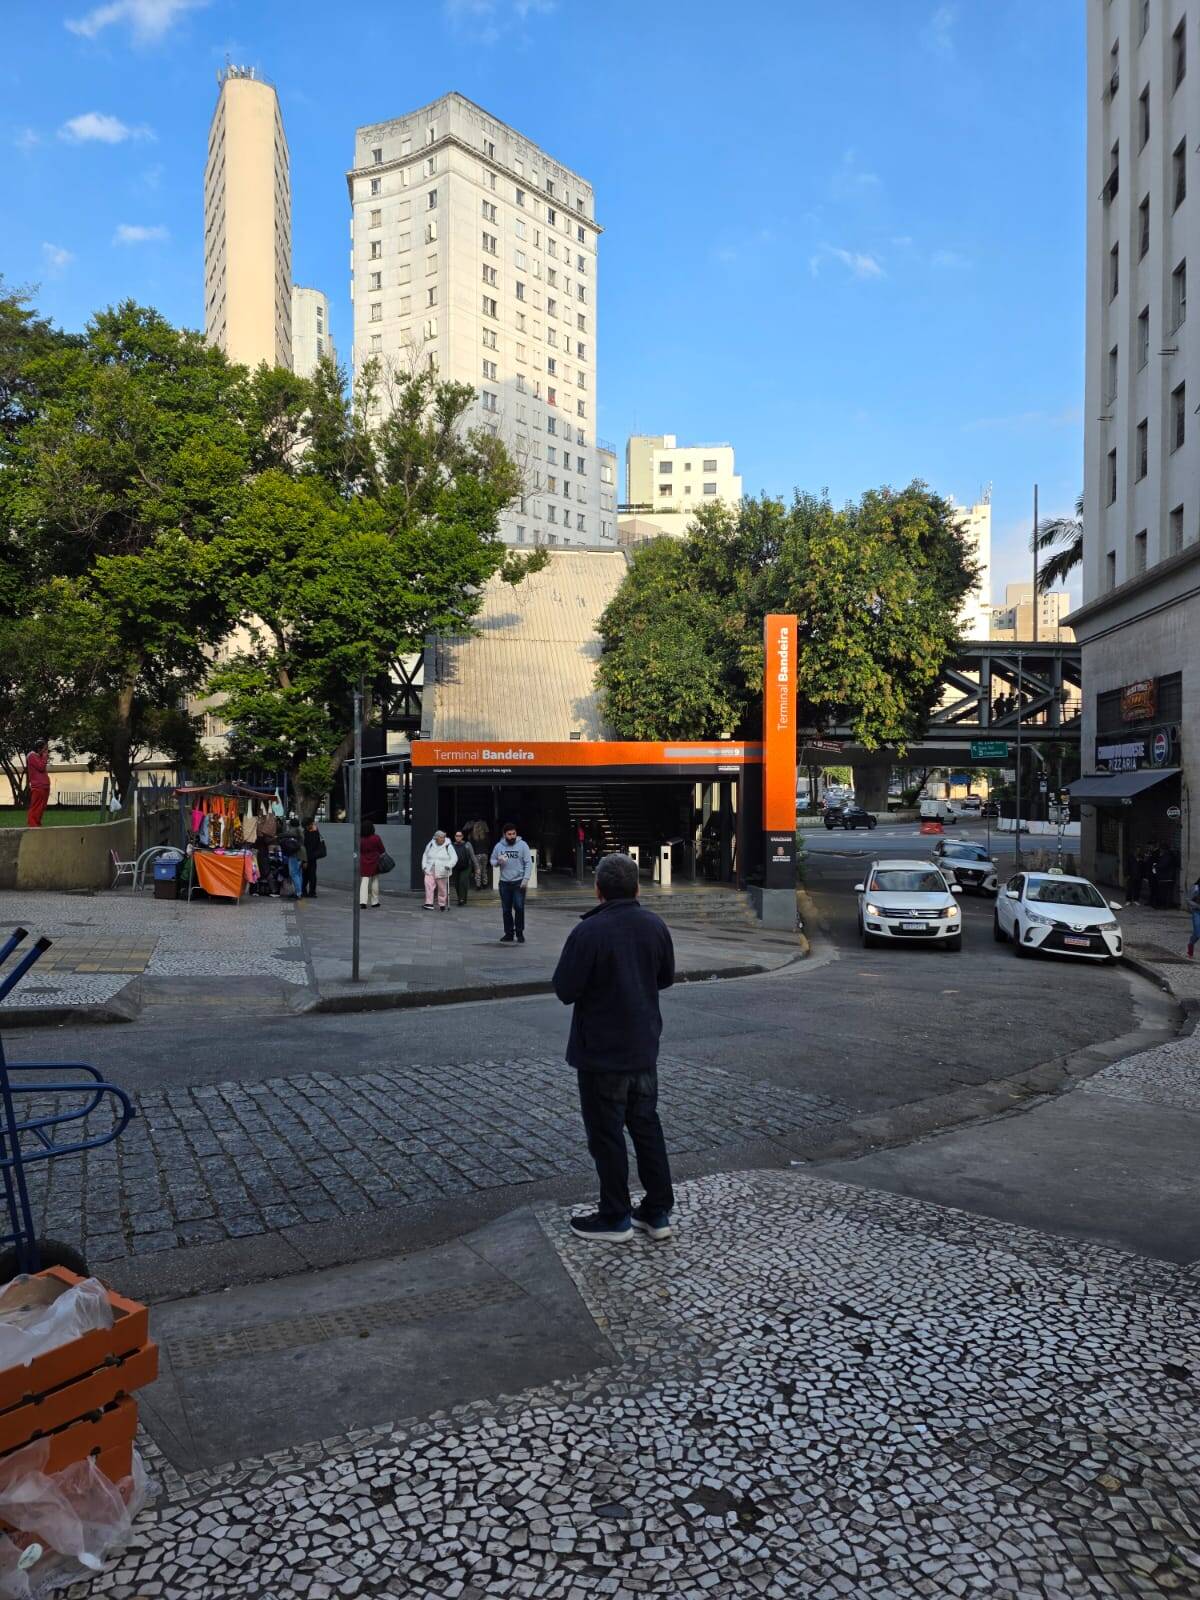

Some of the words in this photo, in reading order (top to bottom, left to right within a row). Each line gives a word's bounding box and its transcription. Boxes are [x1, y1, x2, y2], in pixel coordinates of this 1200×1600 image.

[778, 627, 789, 682] Bandeira
[776, 684, 788, 731] Terminal
[433, 749, 480, 760] Terminal
[482, 749, 535, 760] Bandeira
[1108, 757, 1137, 771] PIZZARIA
